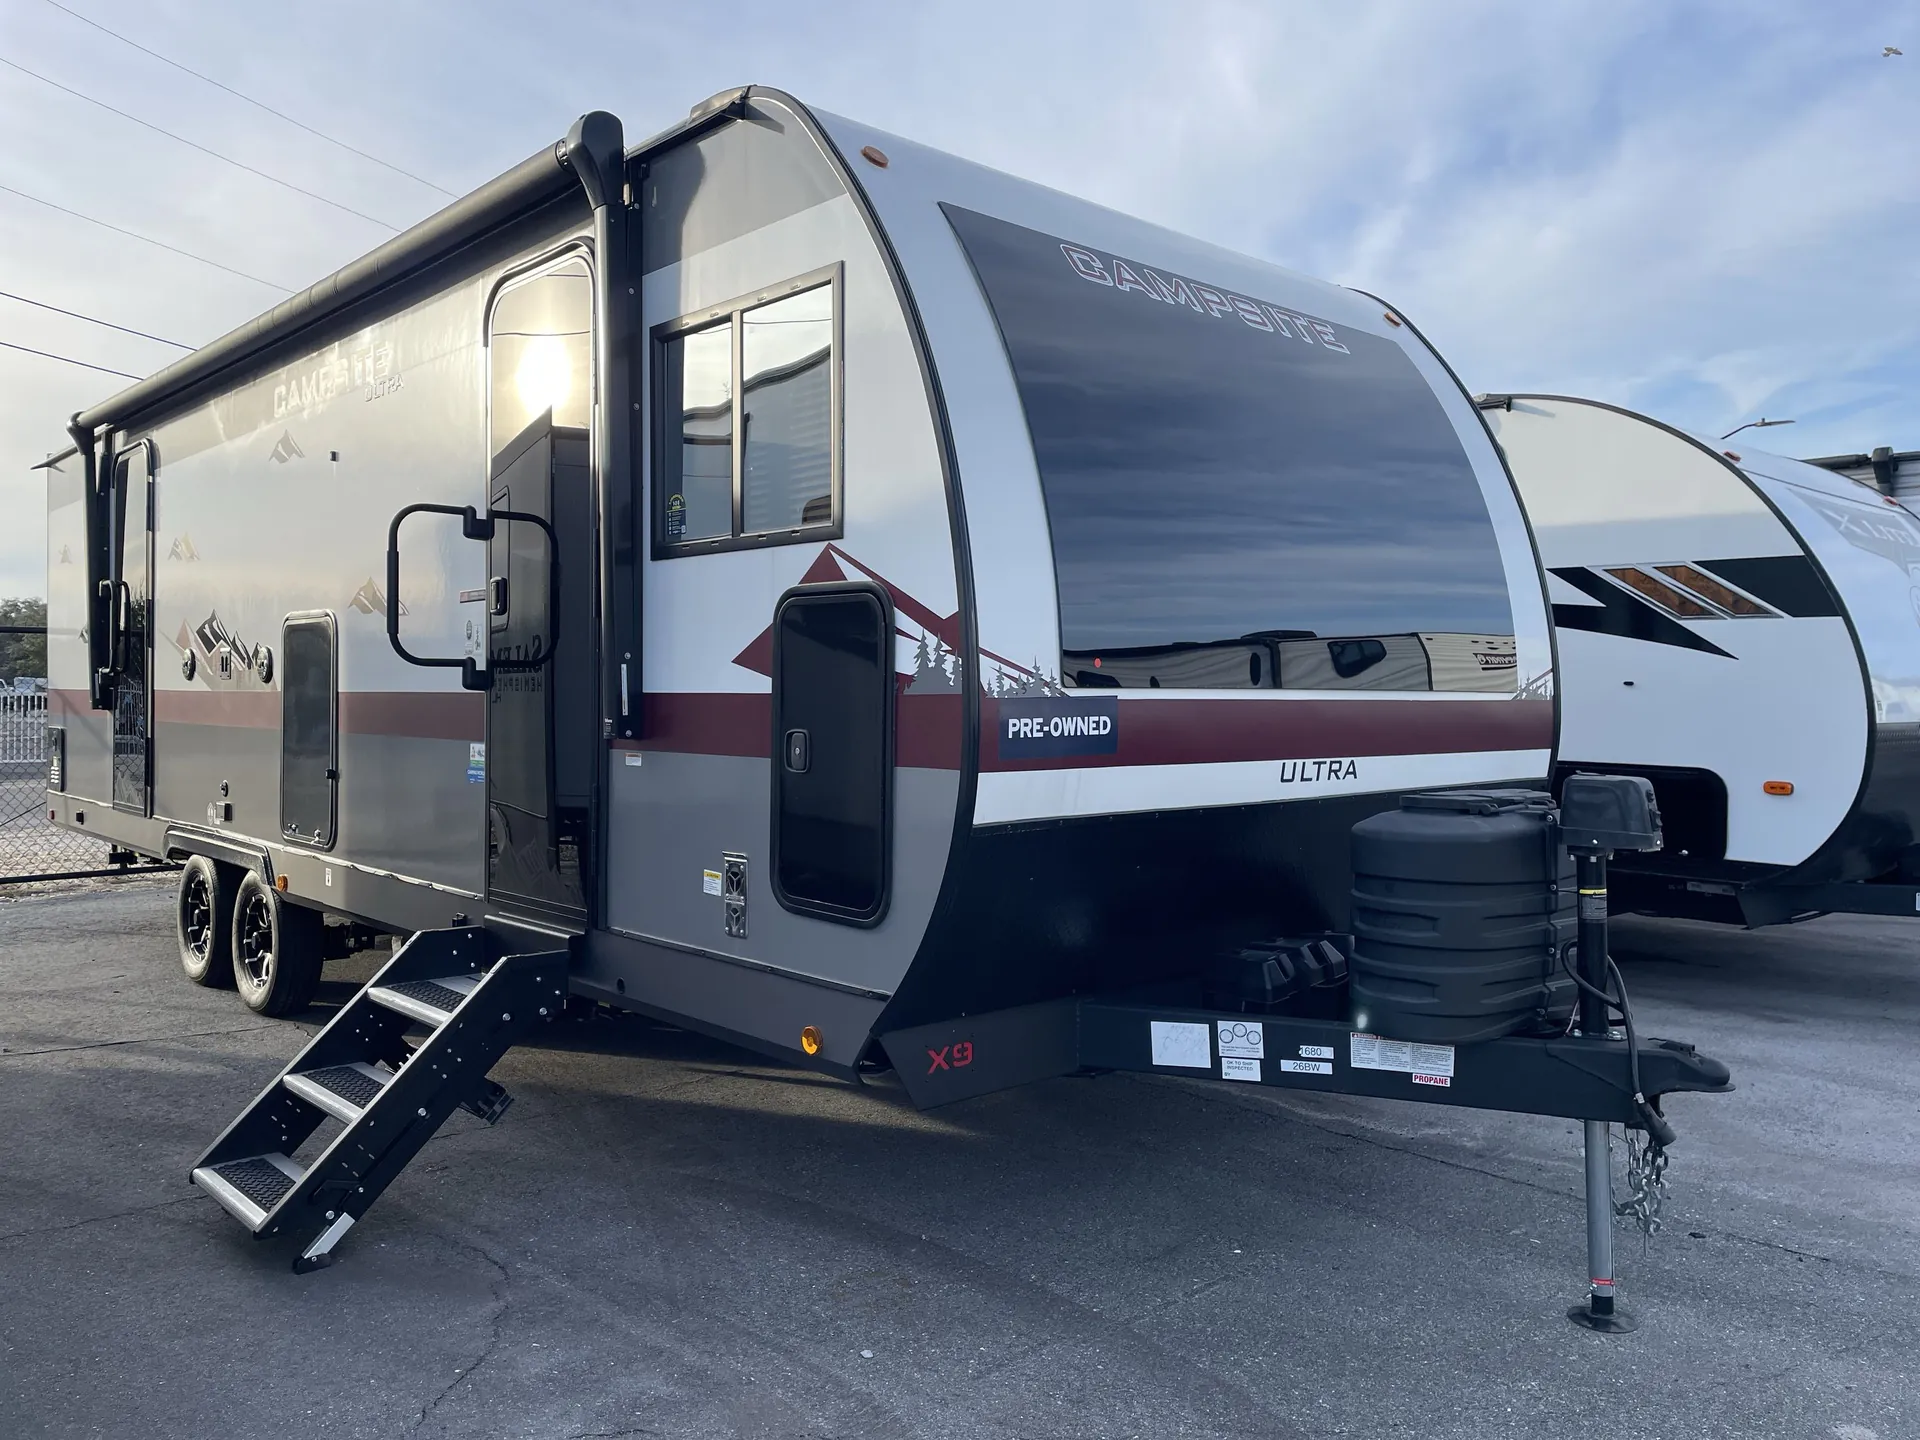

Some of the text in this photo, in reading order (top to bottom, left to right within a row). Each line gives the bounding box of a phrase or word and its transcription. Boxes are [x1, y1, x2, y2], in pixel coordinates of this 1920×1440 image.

[1059, 243, 1350, 354] CAMPSITE
[364, 372, 404, 402] ULTRA
[1008, 716, 1112, 738] PRE-OWNED
[1280, 760, 1358, 783] ULTRA
[927, 1041, 973, 1075] X9
[1292, 1062, 1321, 1072] 26BW
[1413, 1074, 1449, 1086] PROPANE
